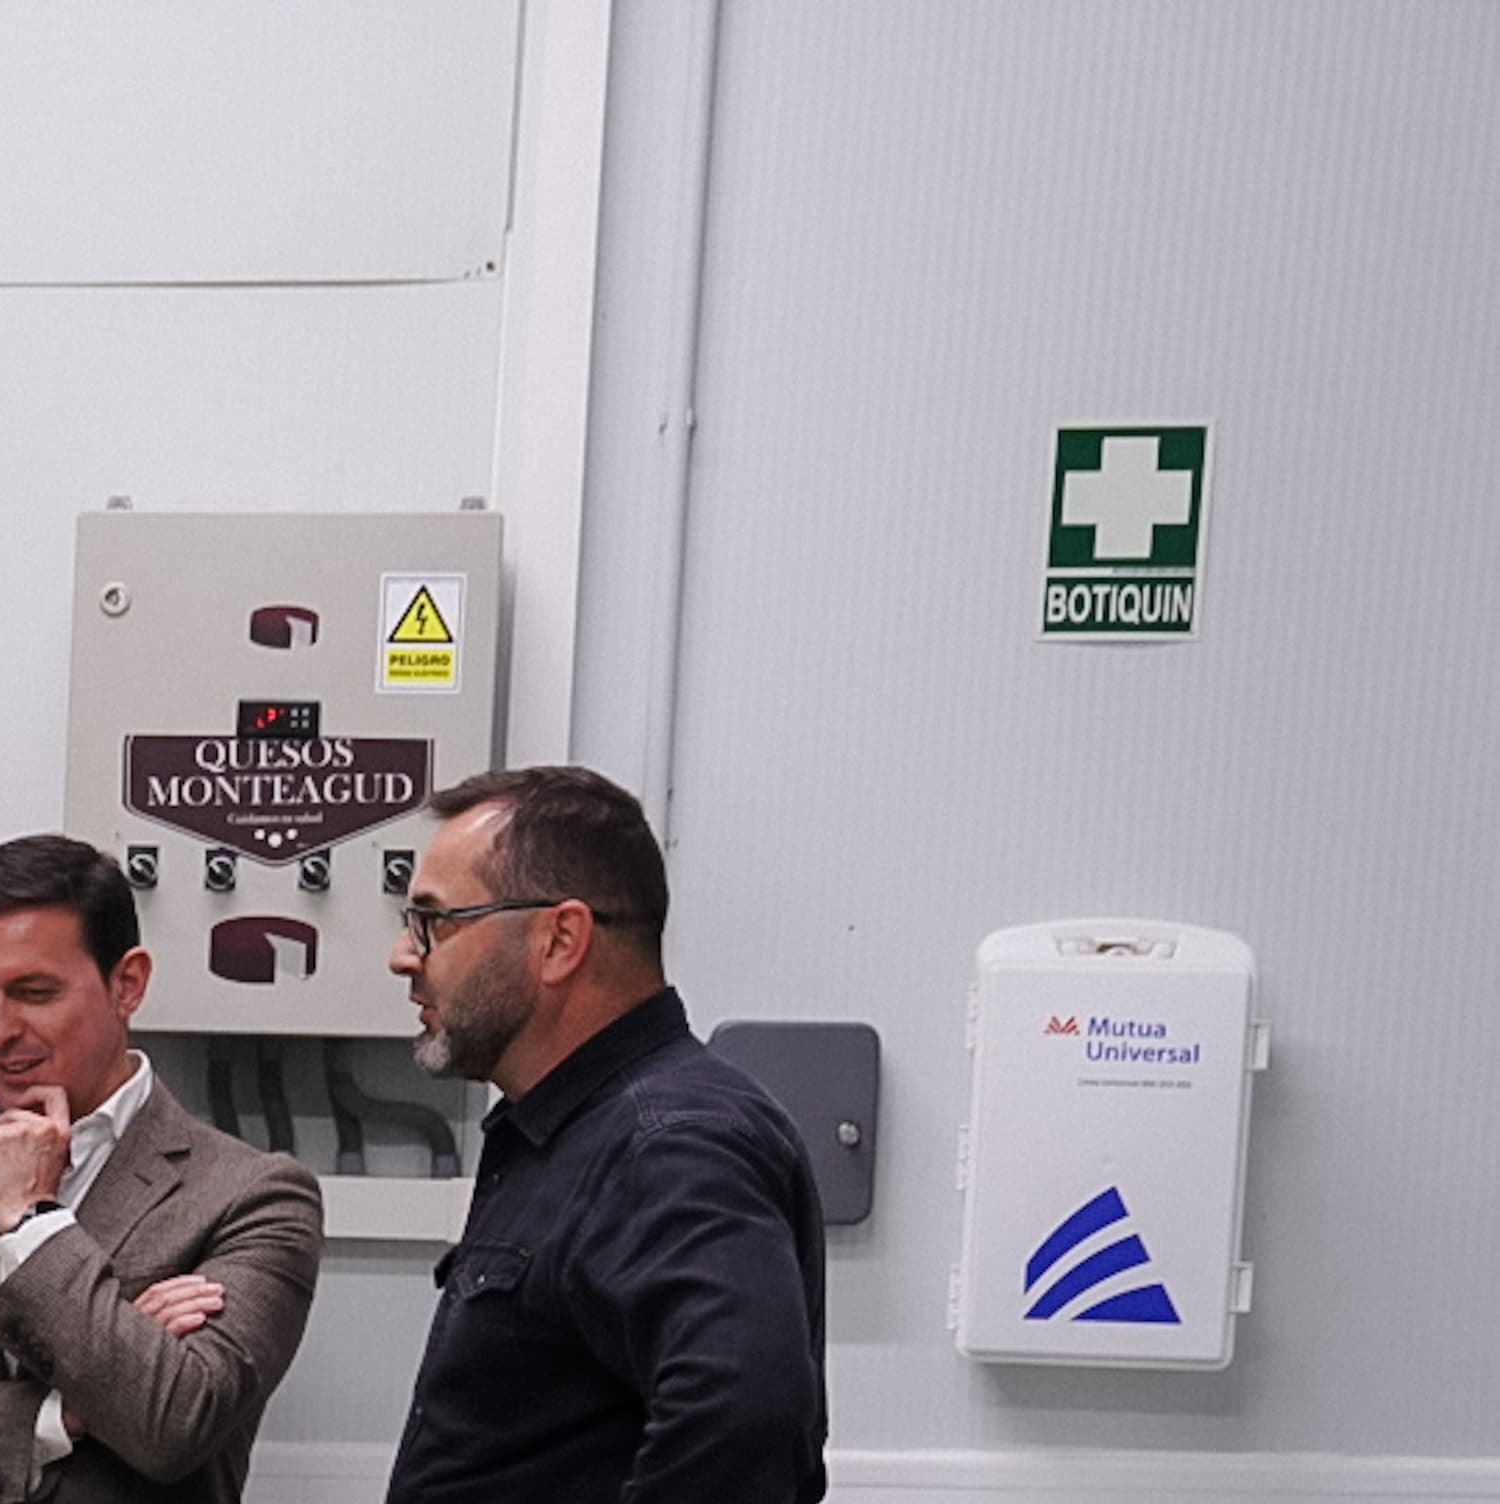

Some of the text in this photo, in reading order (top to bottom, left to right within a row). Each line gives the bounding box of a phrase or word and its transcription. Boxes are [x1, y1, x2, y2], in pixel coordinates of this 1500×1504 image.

[1046, 583, 1193, 625] BOTIQUIN
[388, 653, 452, 667] PELIGRO
[195, 738, 355, 773] QUESOS
[147, 772, 414, 807] MONTEAGUD
[1087, 1016, 1167, 1038] Mutua
[1086, 1041, 1200, 1064] Universal
